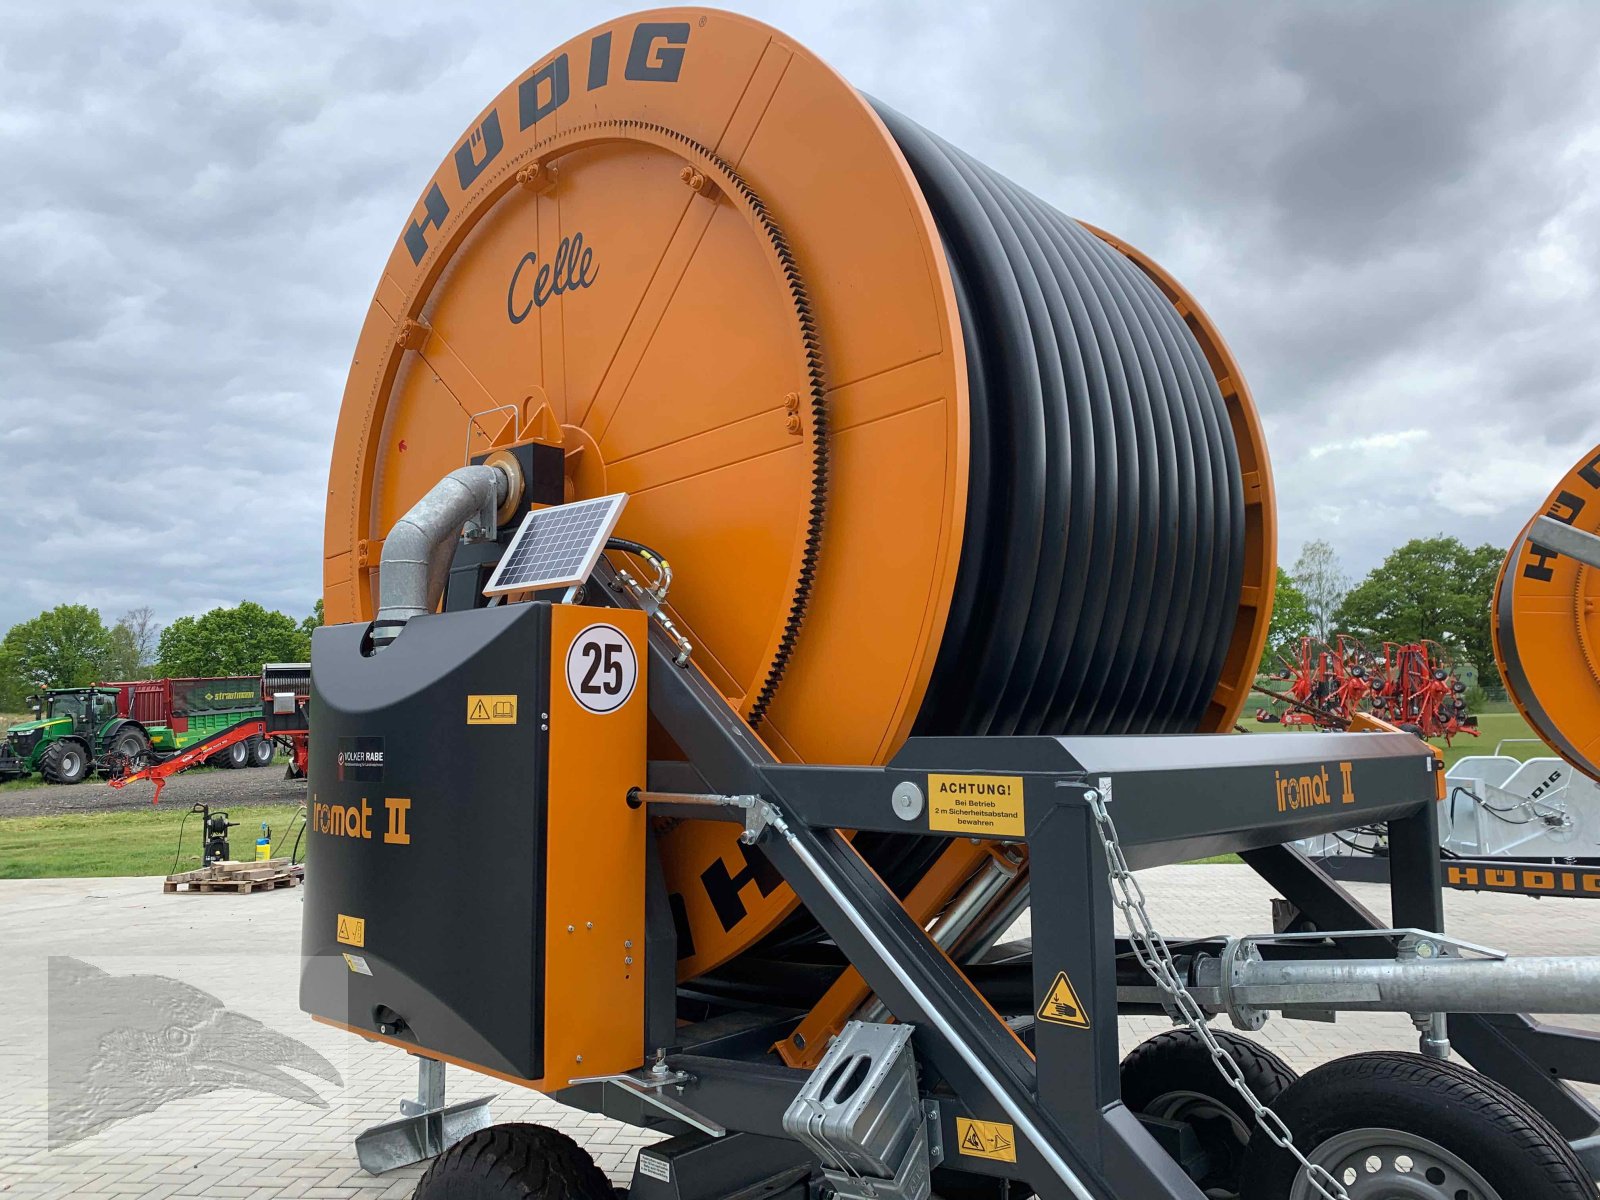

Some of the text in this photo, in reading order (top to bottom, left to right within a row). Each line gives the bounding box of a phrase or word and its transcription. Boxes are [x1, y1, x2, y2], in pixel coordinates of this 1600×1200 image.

[403, 22, 691, 267] HÜDIG
[507, 232, 600, 324] Celle
[579, 641, 624, 695] 25
[344, 751, 384, 761] VOLKER RABE
[940, 782, 1012, 796] ACHTUNG!
[1275, 765, 1331, 812] iromat
[1527, 770, 1562, 799] DIG
[313, 793, 373, 839] iromat
[948, 808, 1018, 819] Sicherheitsabstand
[968, 800, 996, 808] Betrieb
[957, 818, 994, 826] bewahren
